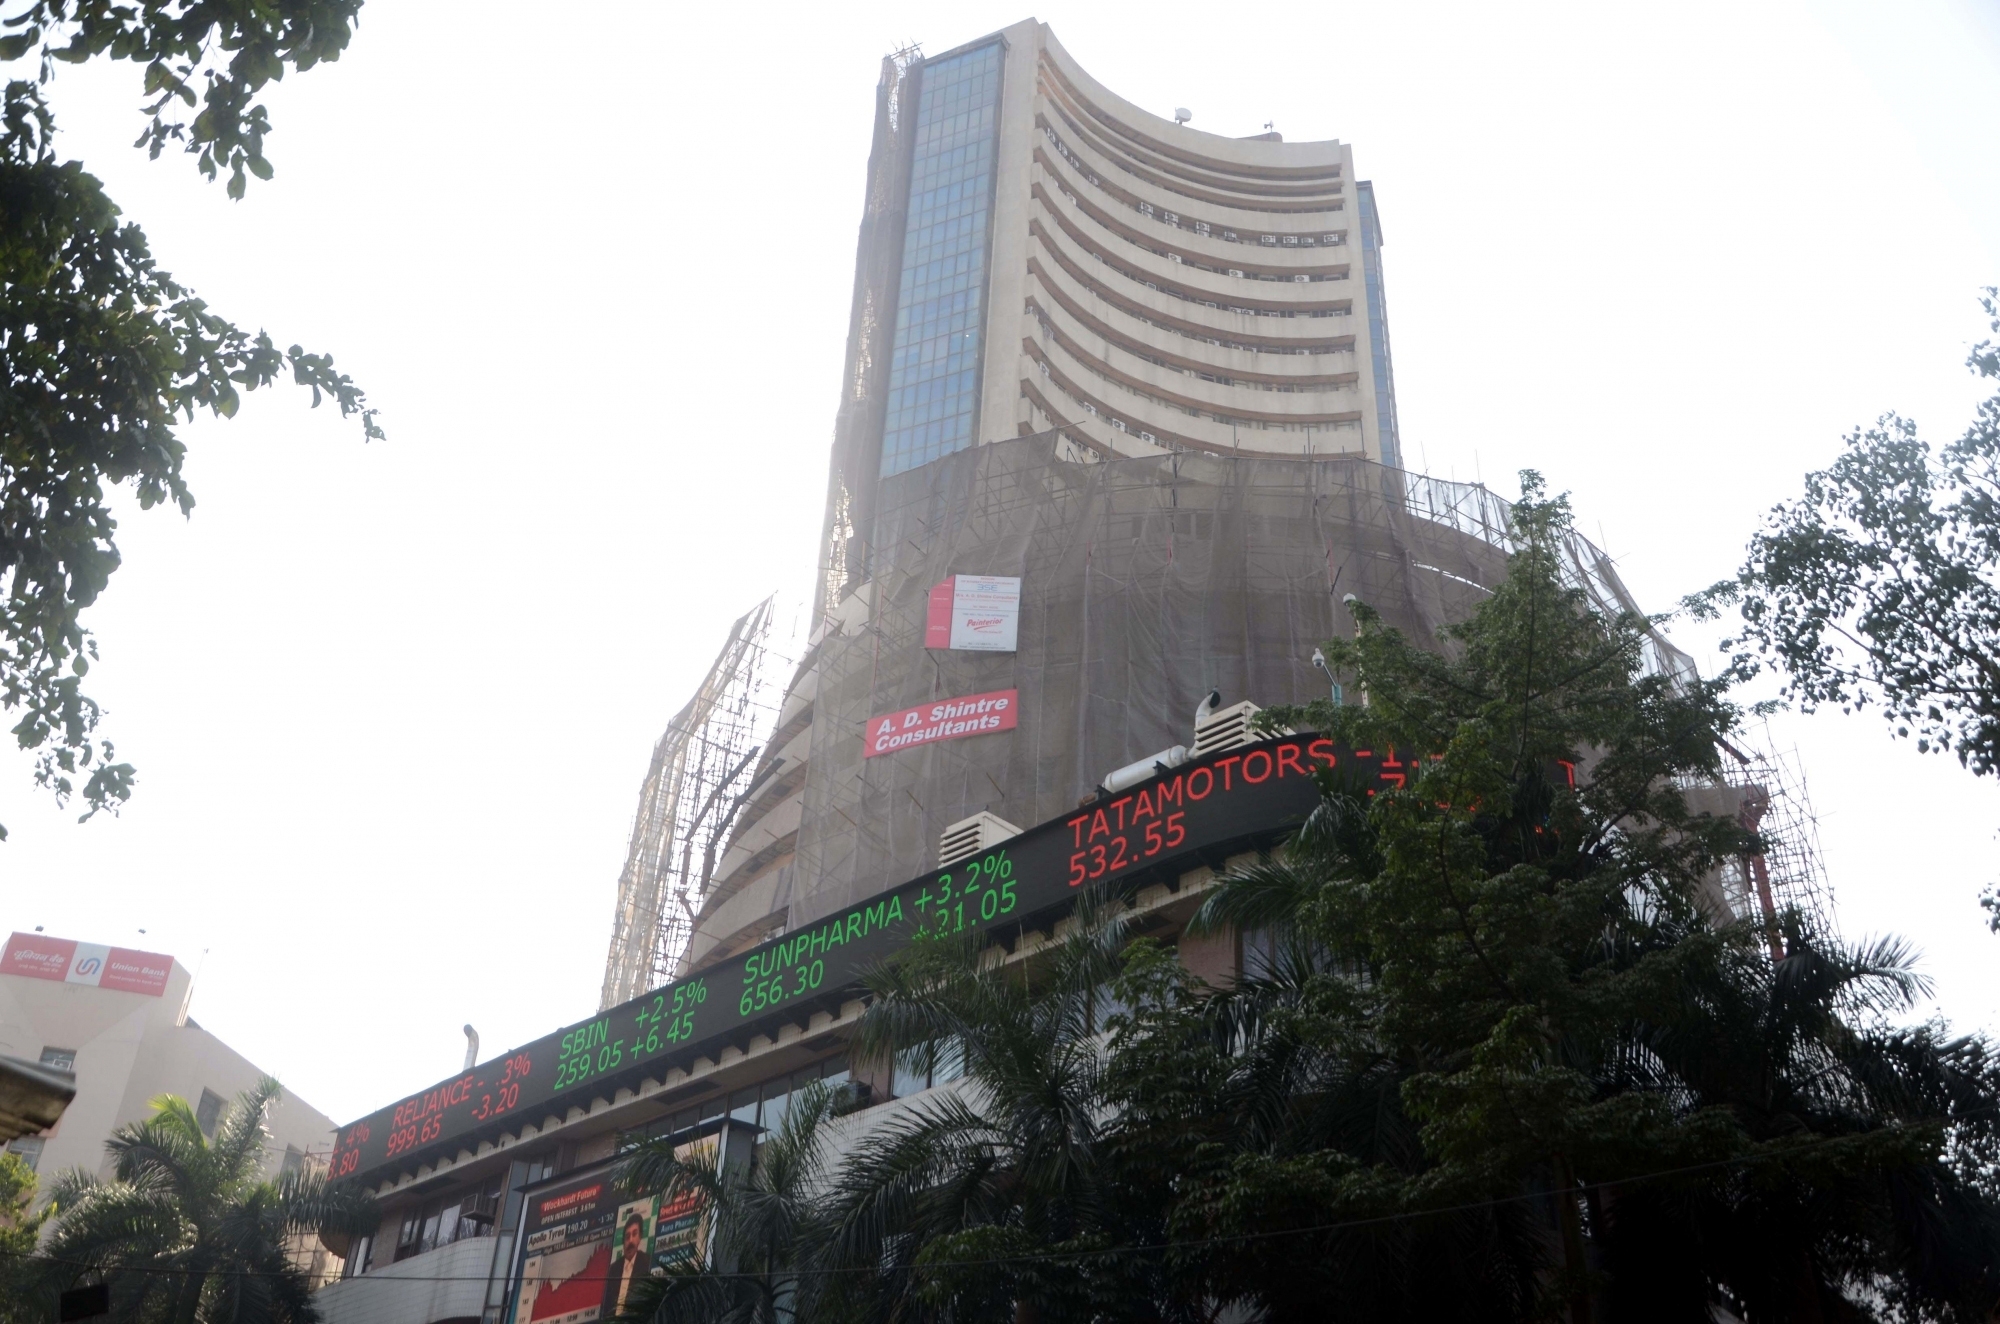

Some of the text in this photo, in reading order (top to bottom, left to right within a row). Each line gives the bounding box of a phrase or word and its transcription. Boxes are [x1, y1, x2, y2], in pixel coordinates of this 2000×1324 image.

[966, 617, 1004, 628] Painterior
[875, 714, 1001, 751] Consultants
[876, 697, 1009, 736] A. D. Shintre
[1067, 739, 1337, 848] TATAMOTORS
[1069, 811, 1186, 887] 532.55
[743, 850, 1013, 985] SUNPHARMA +3.2%
[111, 962, 140, 973] Union
[141, 966, 167, 977] Bank
[739, 959, 824, 1016] 656.30
[559, 978, 707, 1060] SBIN +2.5%
[554, 1011, 695, 1090] 259.05 +6.45
[387, 1114, 443, 1157] 999.65
[471, 1082, 519, 1121] -3.20
[392, 1075, 474, 1129] RELIANCE
[541, 1215, 554, 1226] OPEN
[554, 1206, 578, 1221] INTEREST
[543, 1188, 597, 1212] Wockhardt Future
[528, 1233, 547, 1247] Apollo
[548, 1228, 565, 1241] Tyres
[567, 1219, 589, 1234] 190.20
